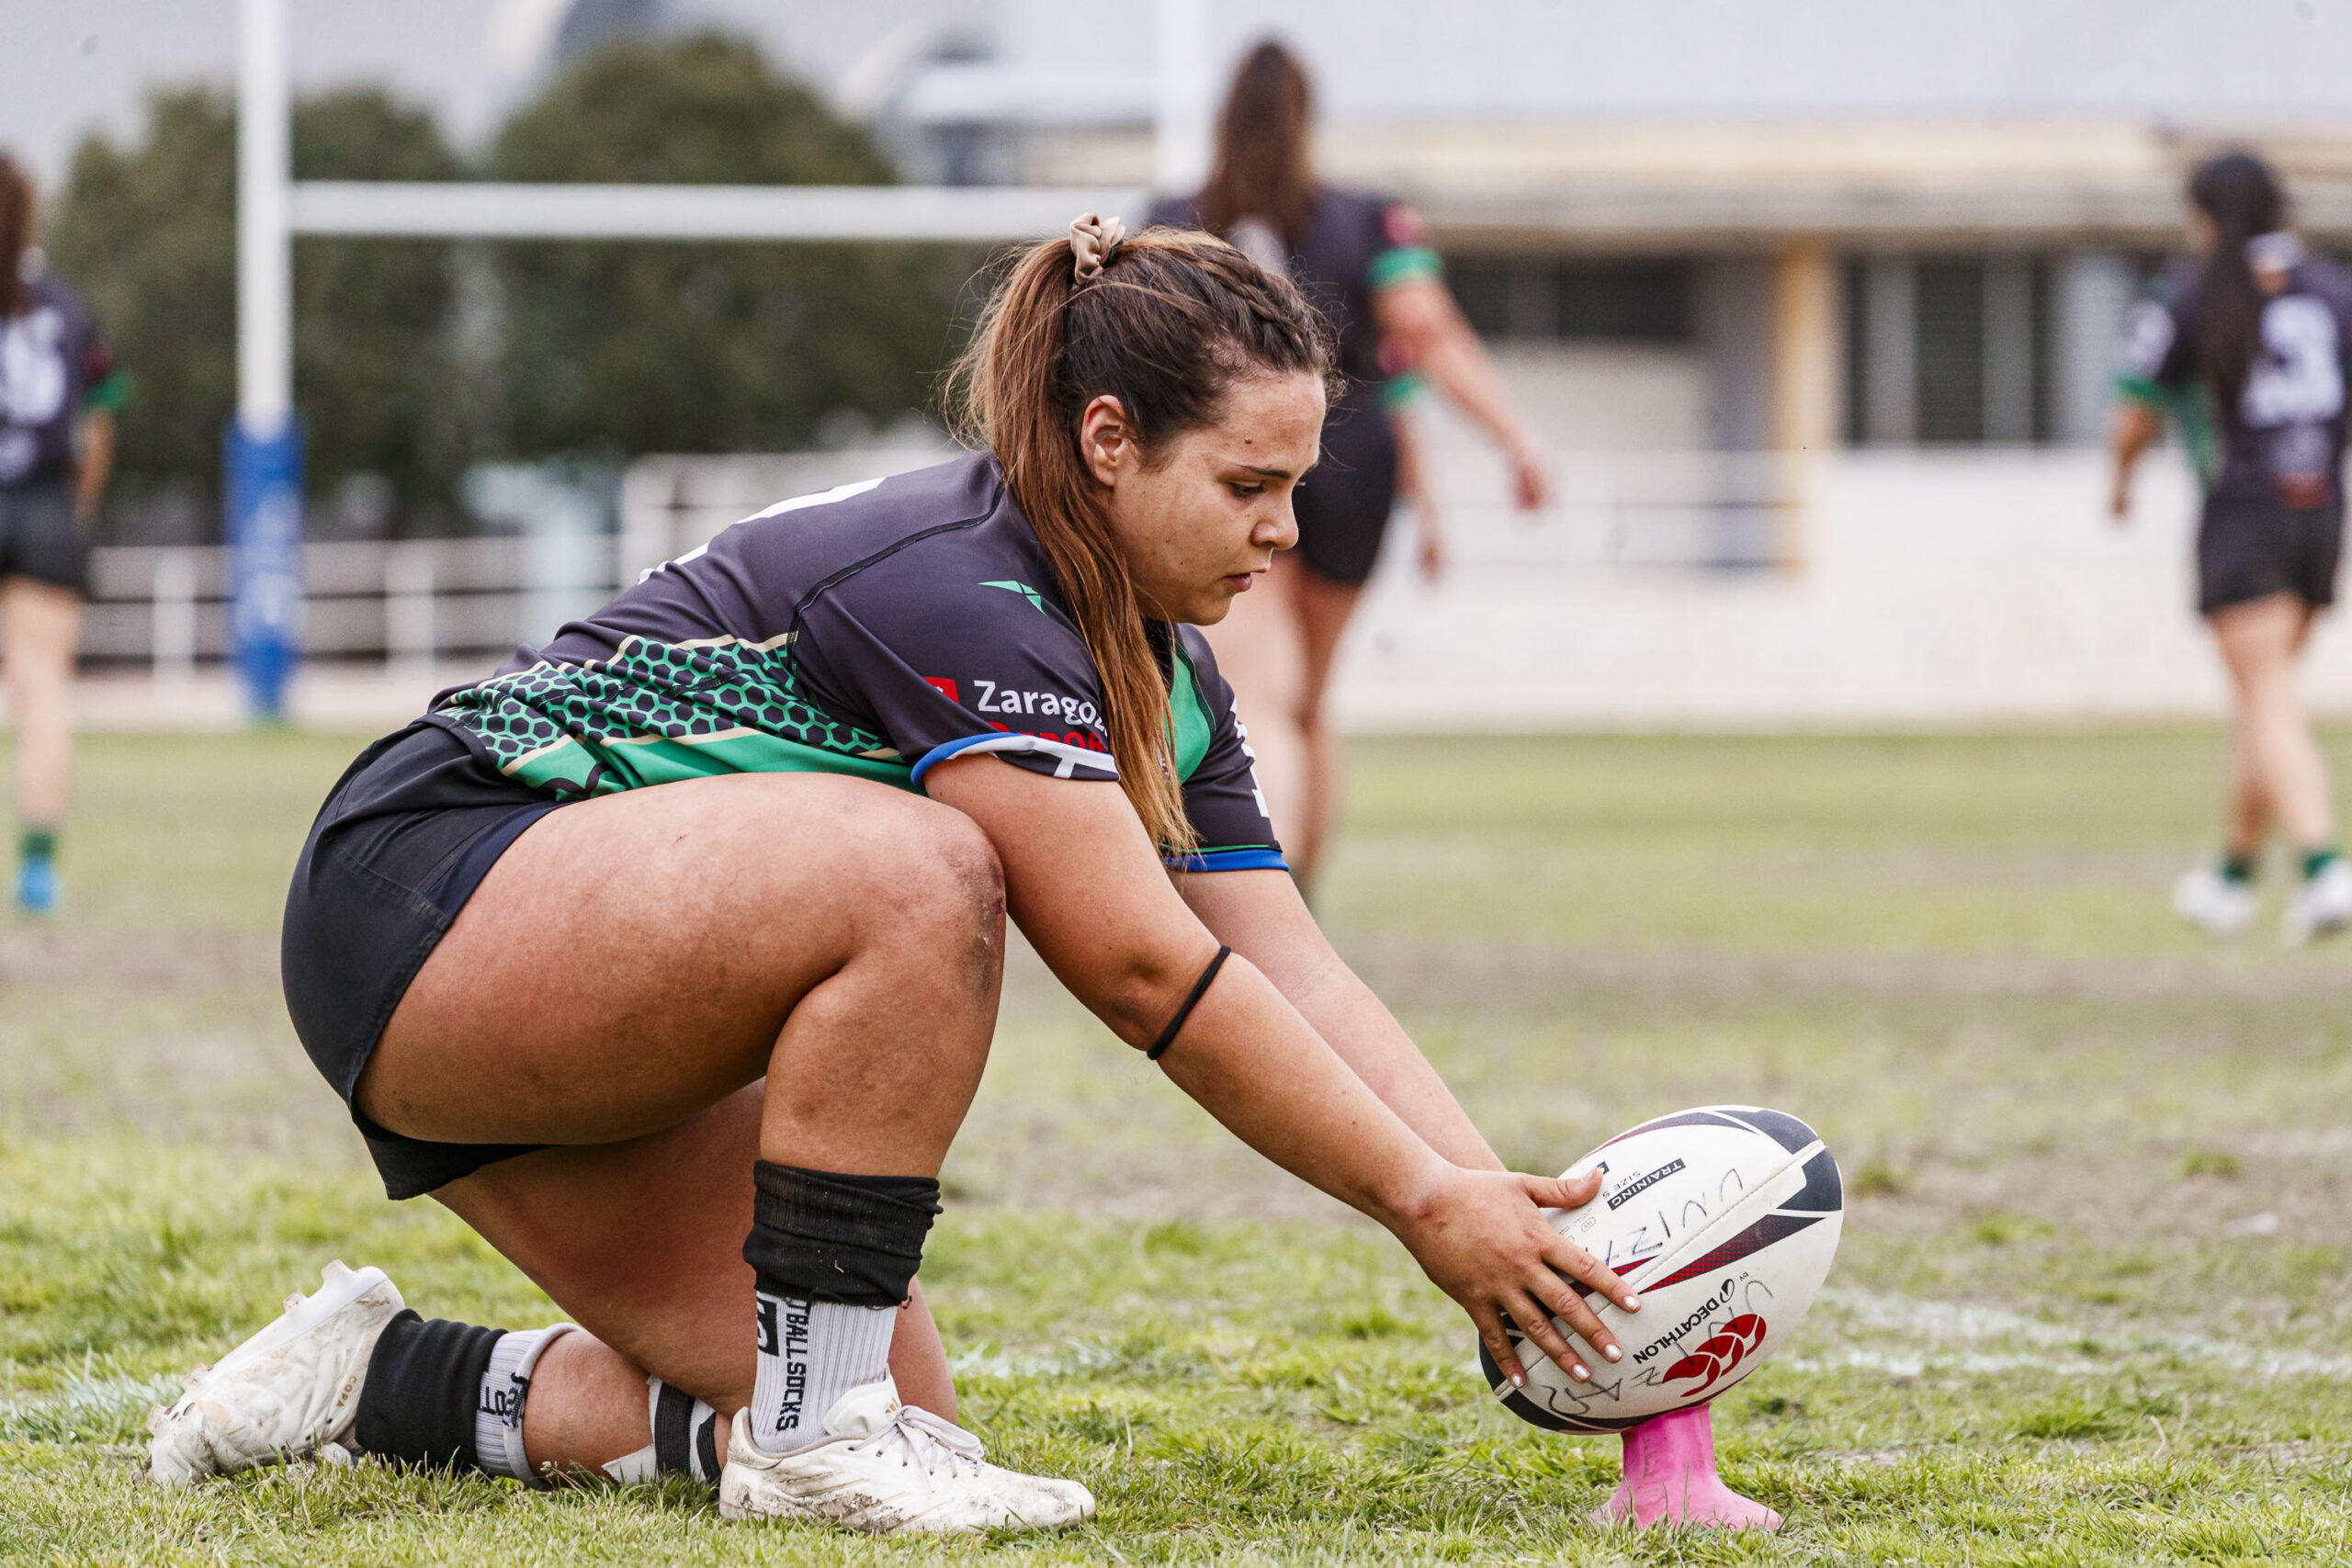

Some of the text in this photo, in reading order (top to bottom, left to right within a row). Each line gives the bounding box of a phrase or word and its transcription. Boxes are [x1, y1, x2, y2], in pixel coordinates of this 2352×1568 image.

[974, 680, 1108, 737] Zaragoz
[1611, 1160, 1683, 1208] TRAINING
[1612, 1170, 1642, 1190] SIZE
[1633, 1297, 1720, 1364] DECATHLON
[336, 1374, 357, 1407] COPA
[775, 1361, 807, 1431] SOCKS
